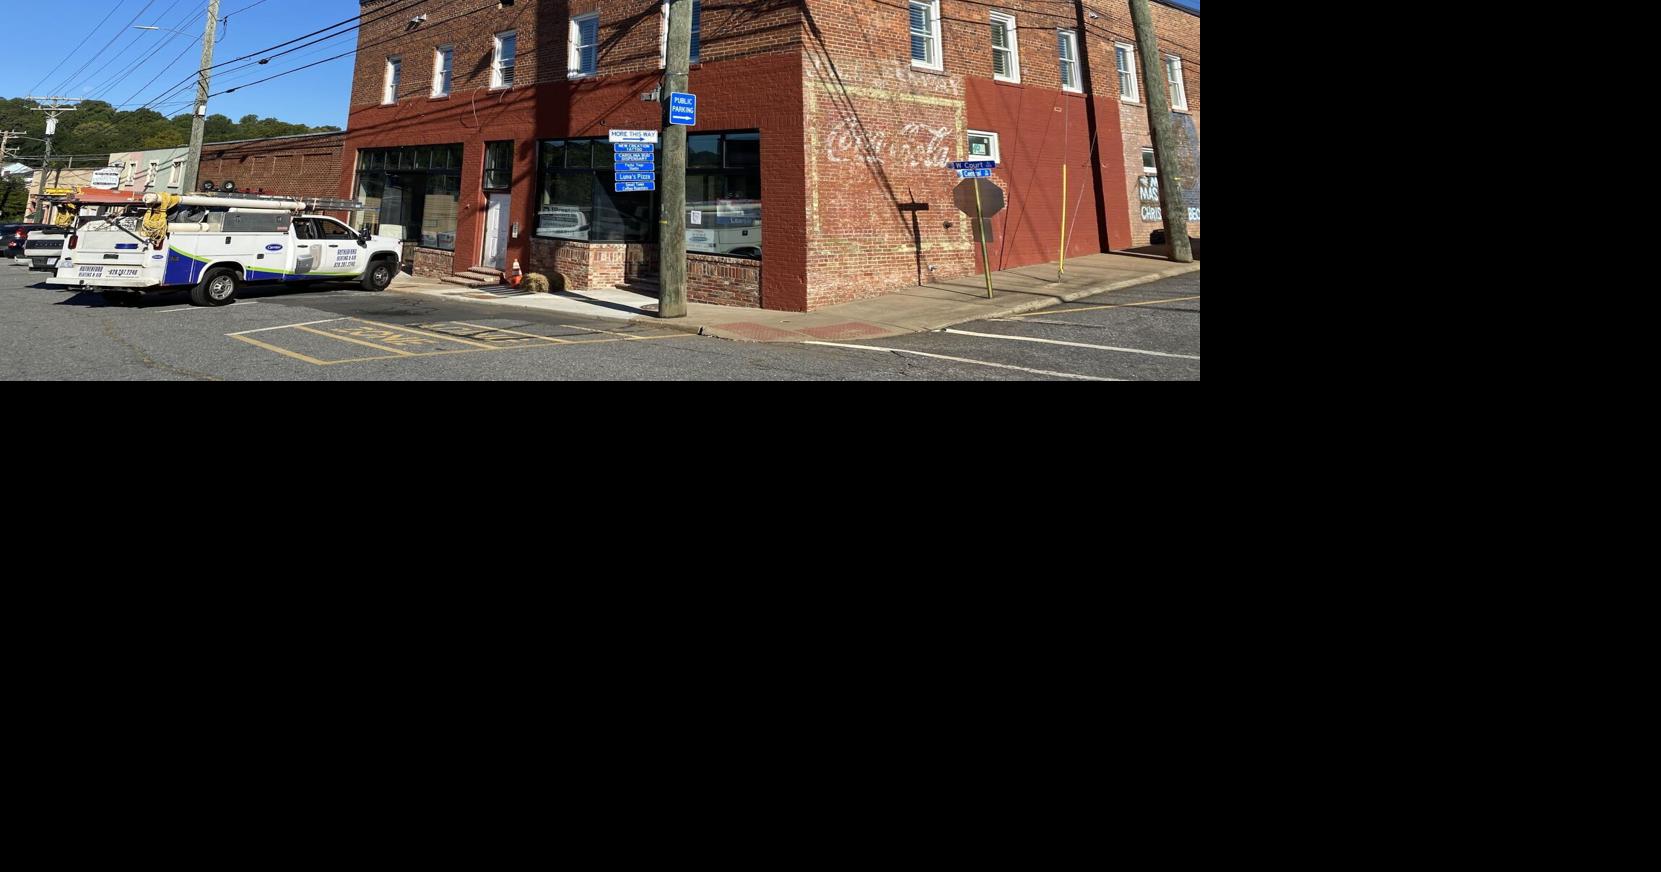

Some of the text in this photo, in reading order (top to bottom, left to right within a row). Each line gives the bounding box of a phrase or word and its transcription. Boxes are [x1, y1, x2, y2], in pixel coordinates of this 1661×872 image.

[674, 97, 693, 105] PUBLIC
[1139, 187, 1159, 201] MAS
[1141, 206, 1162, 220] CHRIS
